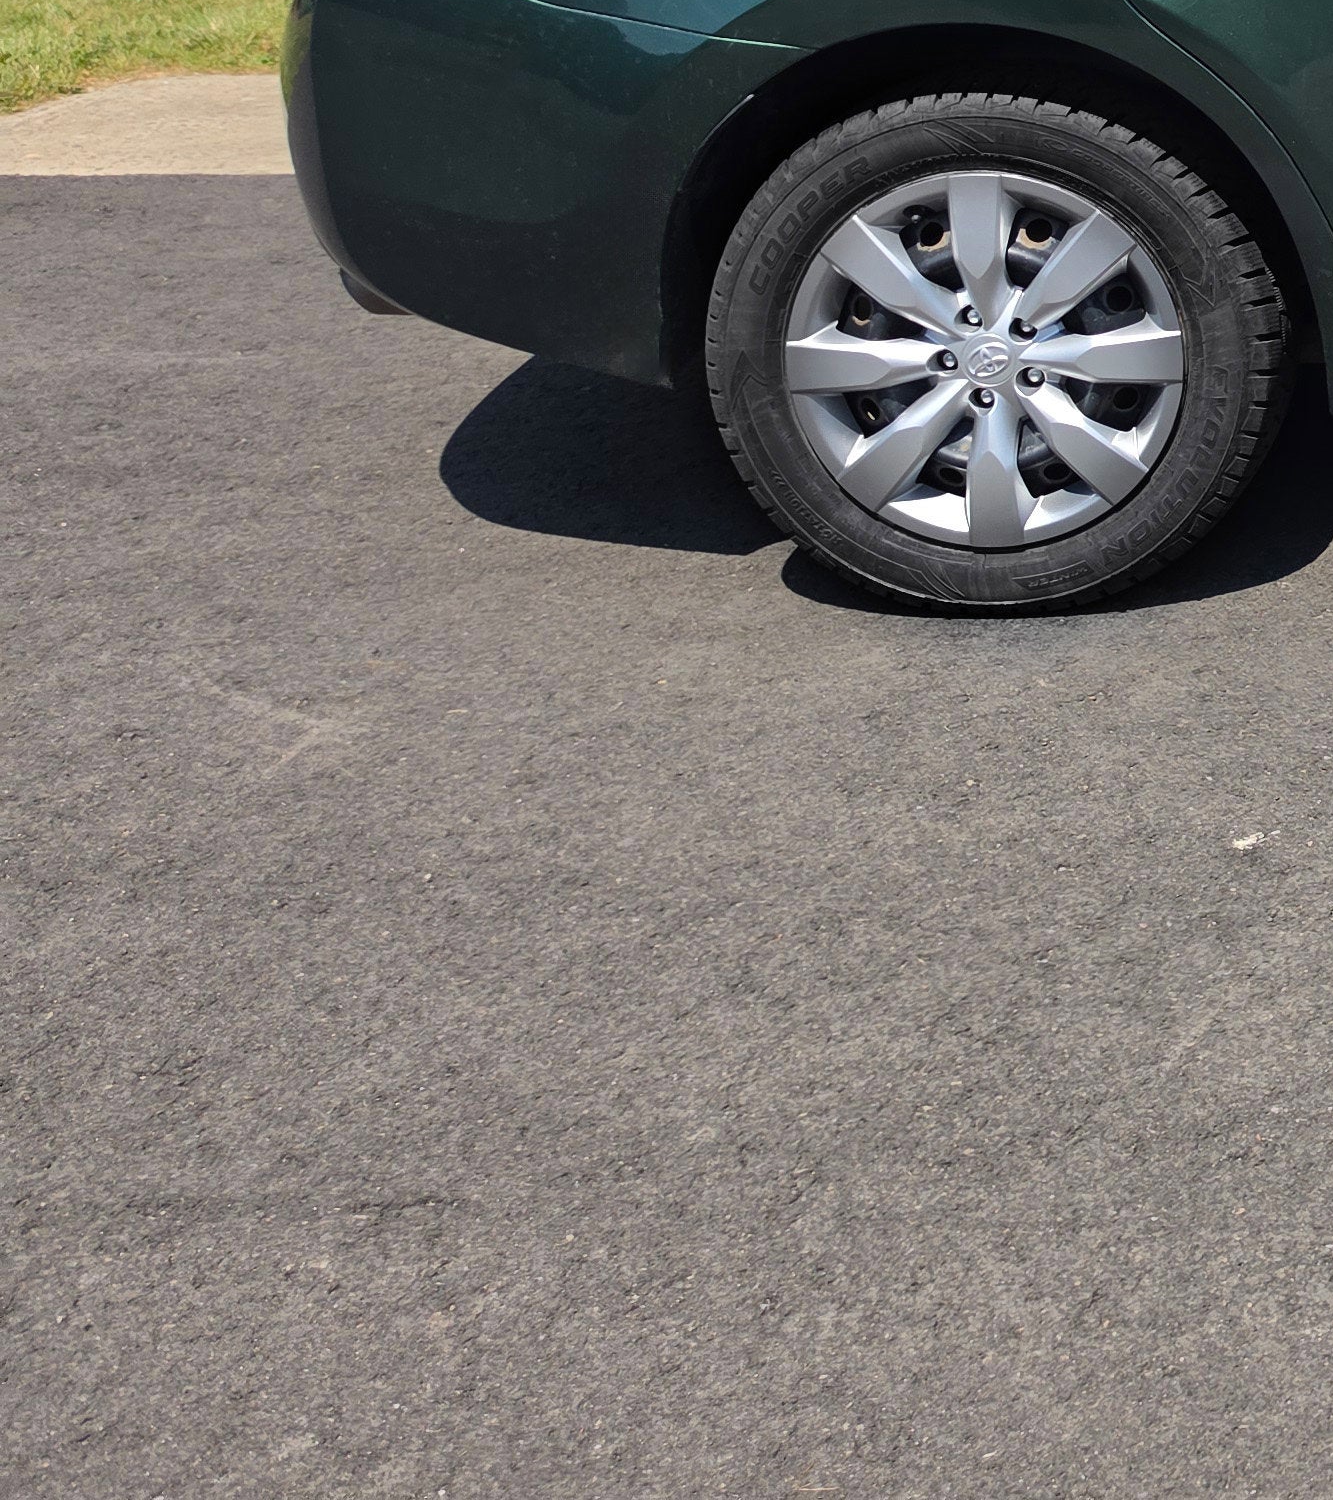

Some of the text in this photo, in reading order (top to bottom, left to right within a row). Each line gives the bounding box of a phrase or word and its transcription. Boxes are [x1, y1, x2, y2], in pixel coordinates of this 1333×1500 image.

[747, 154, 873, 296] COOPER
[1101, 364, 1232, 568] EVOLUTION
[1026, 565, 1088, 589] WINTER
